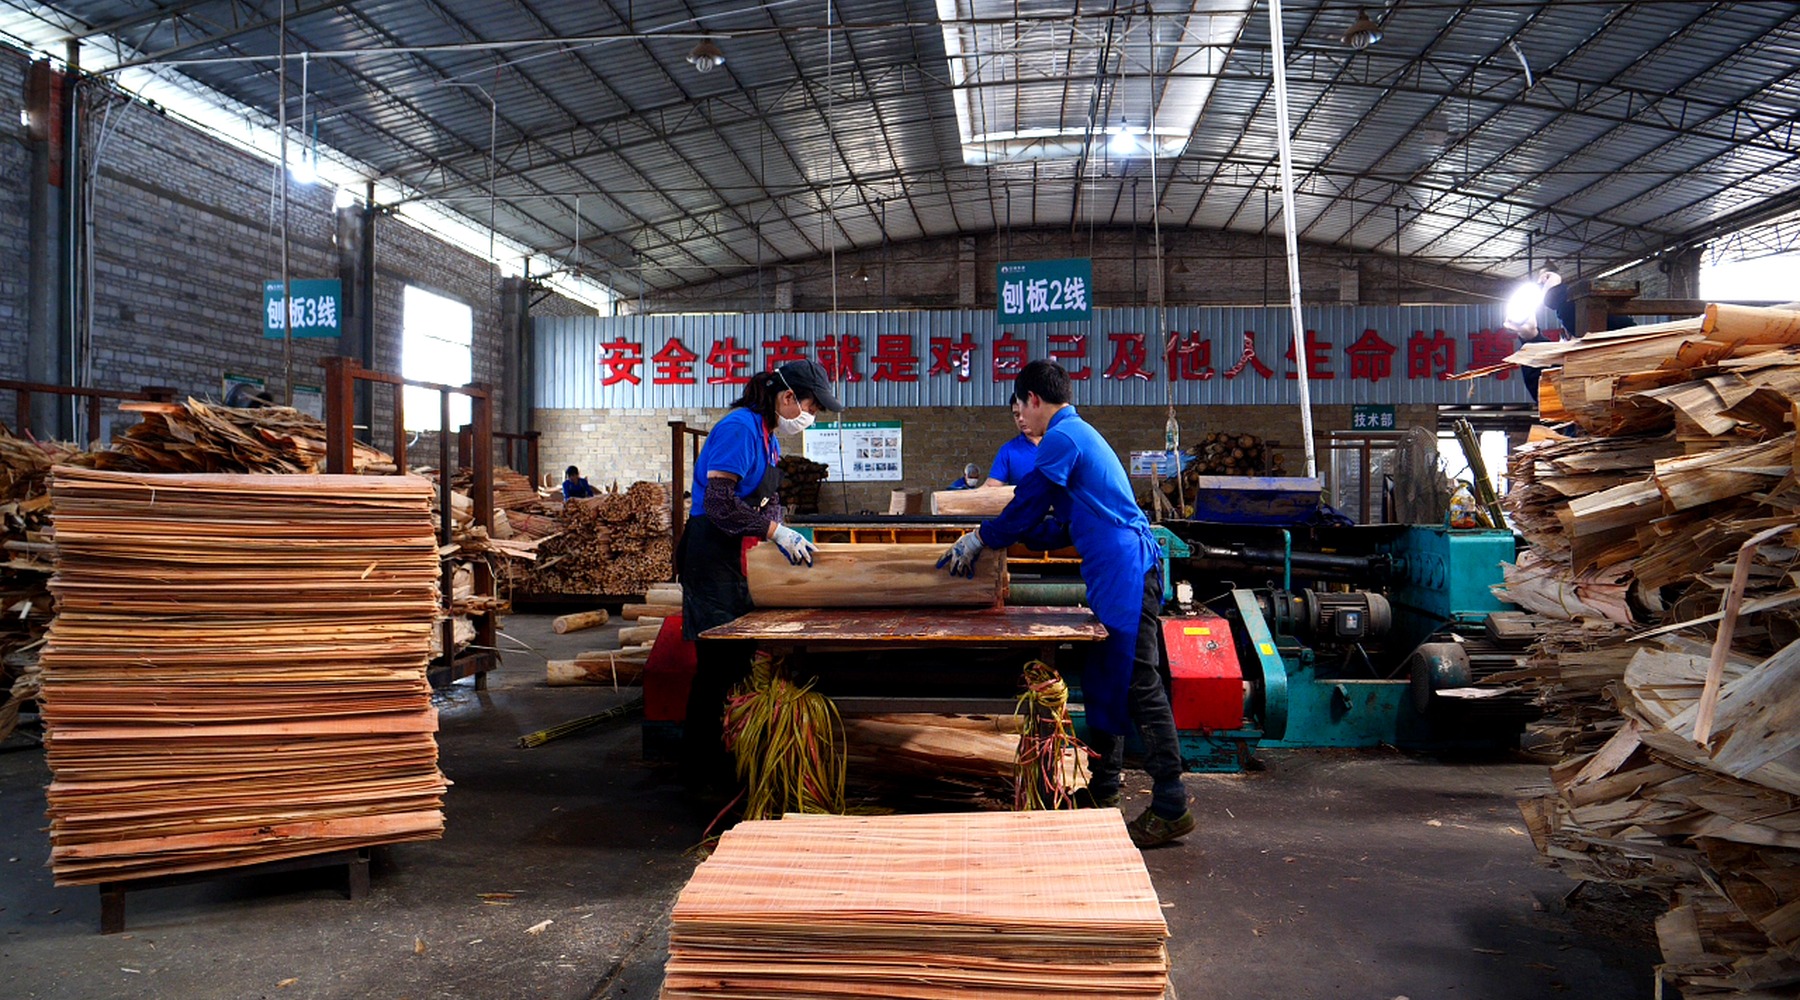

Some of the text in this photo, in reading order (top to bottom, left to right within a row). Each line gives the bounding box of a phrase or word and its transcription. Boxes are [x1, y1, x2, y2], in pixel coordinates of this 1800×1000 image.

[267, 295, 337, 329] 刨板3线
[1002, 277, 1087, 314] 刨板2线
[599, 329, 1564, 386] 安全生产就是对自己及他人生命的尊
[1354, 412, 1393, 428] 技术部
